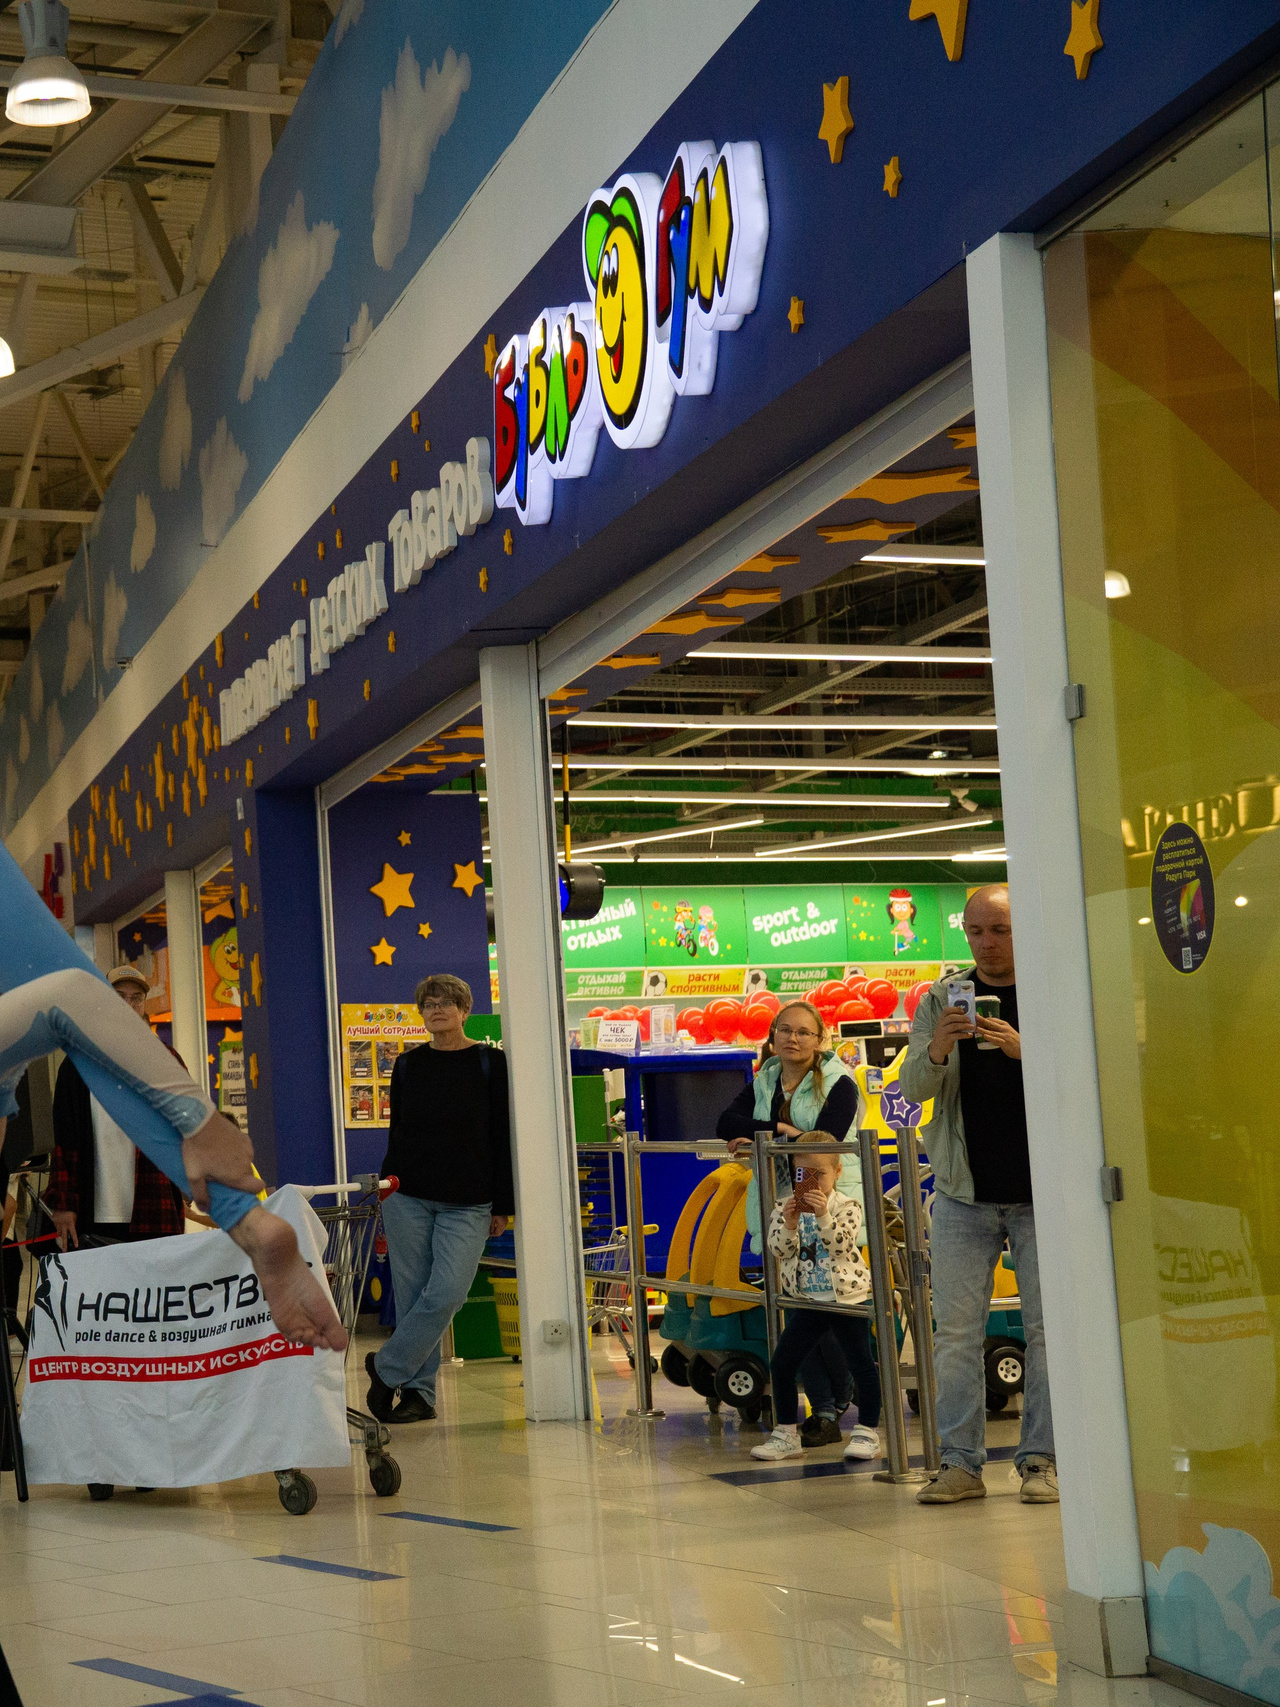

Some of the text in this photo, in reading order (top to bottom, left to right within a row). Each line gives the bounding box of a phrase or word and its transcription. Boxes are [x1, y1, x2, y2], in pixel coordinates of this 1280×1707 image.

[752, 901, 821, 934] sport &
[770, 917, 839, 947] outdoor
[578, 971, 626, 985] отдыхай
[688, 972, 720, 984] расти
[781, 967, 827, 980] отдыхай
[885, 968, 916, 979] расти
[577, 986, 625, 995] активно
[670, 984, 740, 995] спортивным
[780, 980, 824, 990] активн
[77, 1272, 267, 1322] НАШЕСТВ
[75, 1329, 101, 1343] pole
[105, 1330, 145, 1342] dance
[148, 1330, 157, 1342] &
[161, 1322, 227, 1343] воздушная
[34, 1361, 79, 1376] ЦЕНТР
[81, 1359, 207, 1377] ВОЗДУШНЫХ
